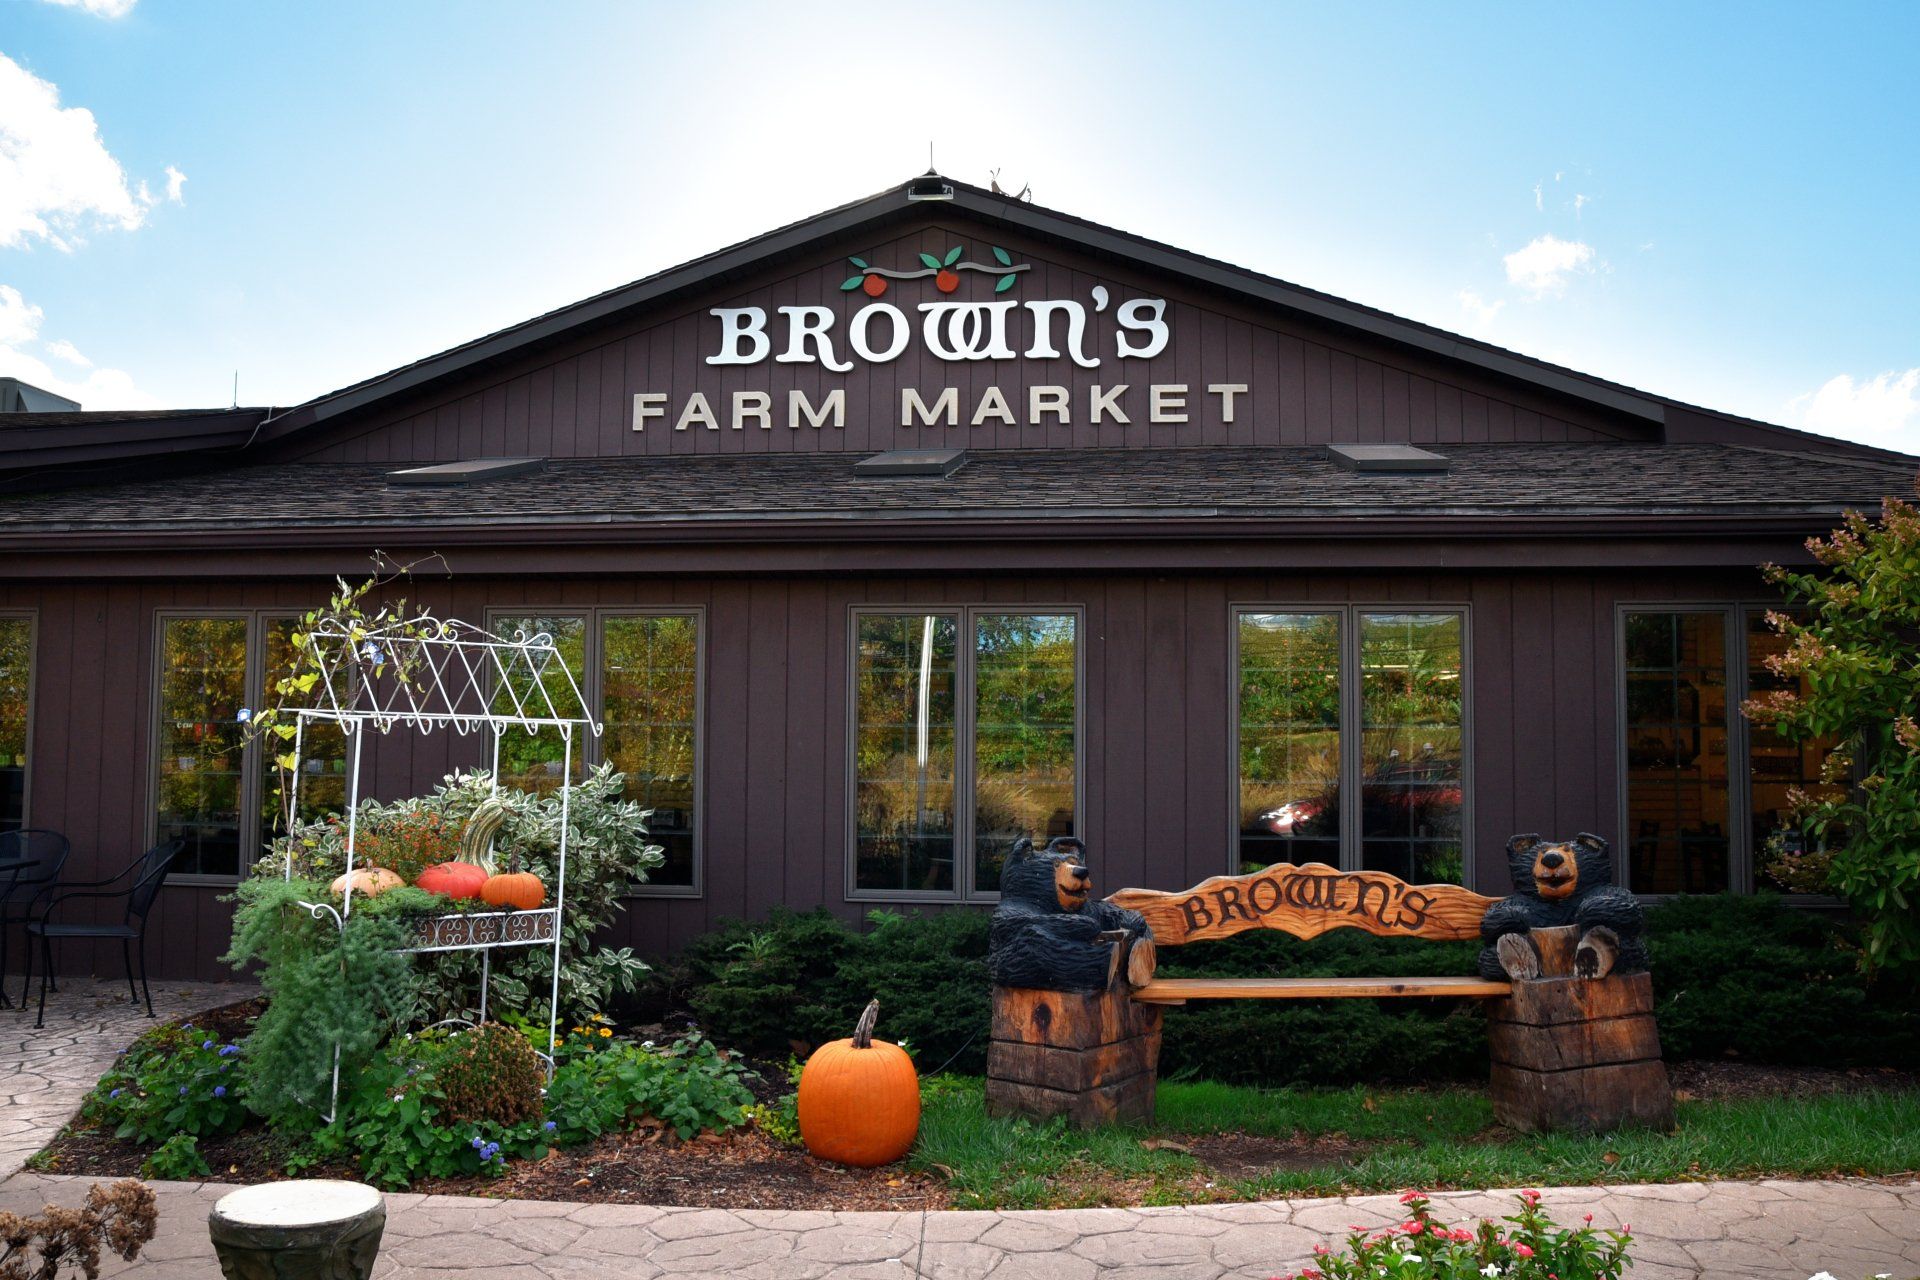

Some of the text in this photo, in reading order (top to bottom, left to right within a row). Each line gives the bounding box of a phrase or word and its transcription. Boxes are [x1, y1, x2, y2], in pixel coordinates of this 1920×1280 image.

[705, 285, 1170, 372] BROWN'S
[632, 384, 1249, 431] FARM MARKET
[1175, 873, 1438, 937] BROWN'S
